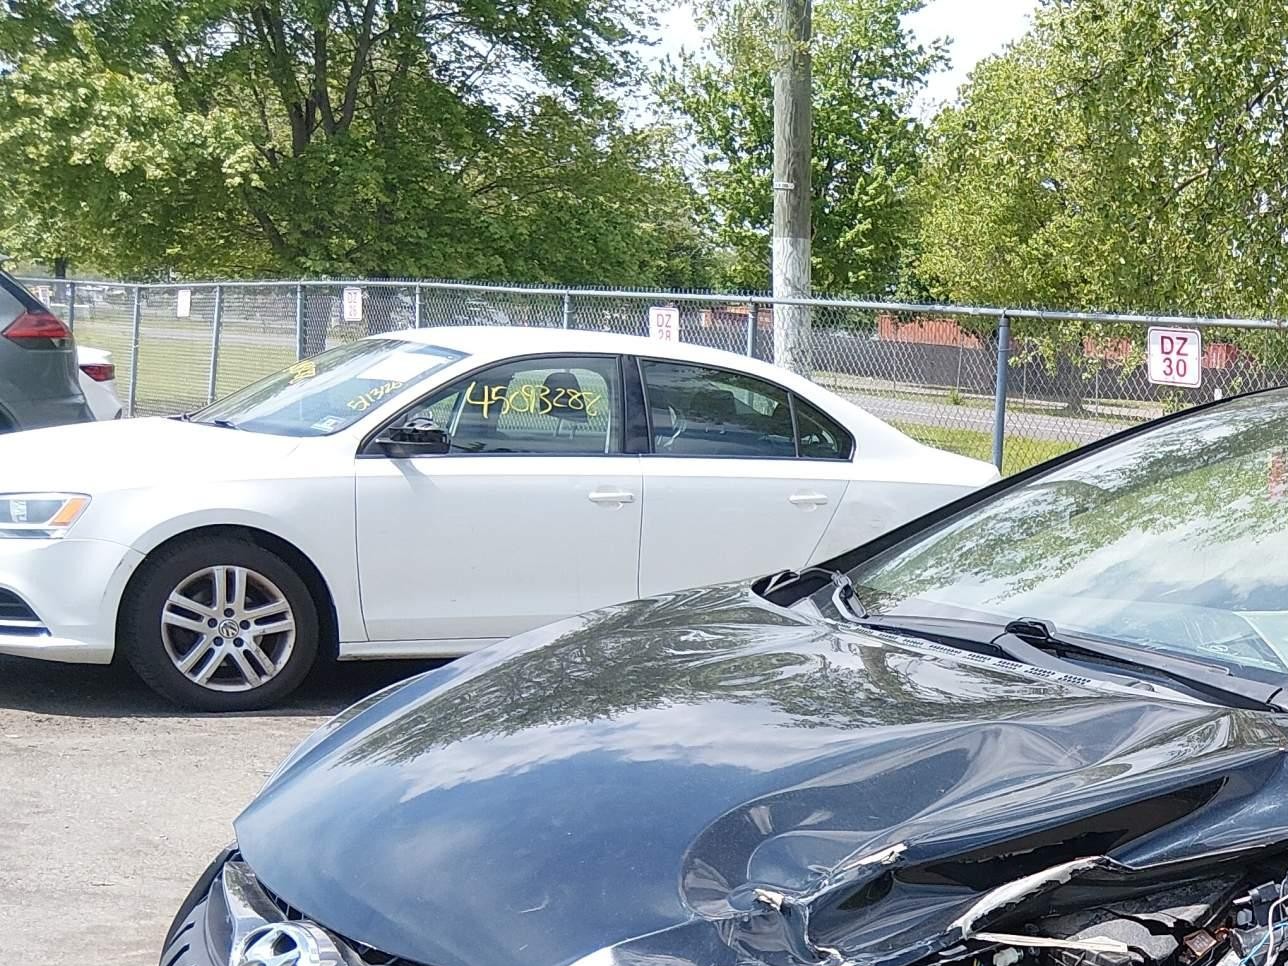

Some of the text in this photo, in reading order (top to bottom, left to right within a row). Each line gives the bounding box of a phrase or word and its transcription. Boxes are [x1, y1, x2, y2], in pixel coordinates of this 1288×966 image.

[656, 313, 672, 328] DZ
[1160, 335, 1189, 356] DZ
[1163, 357, 1187, 377] 30
